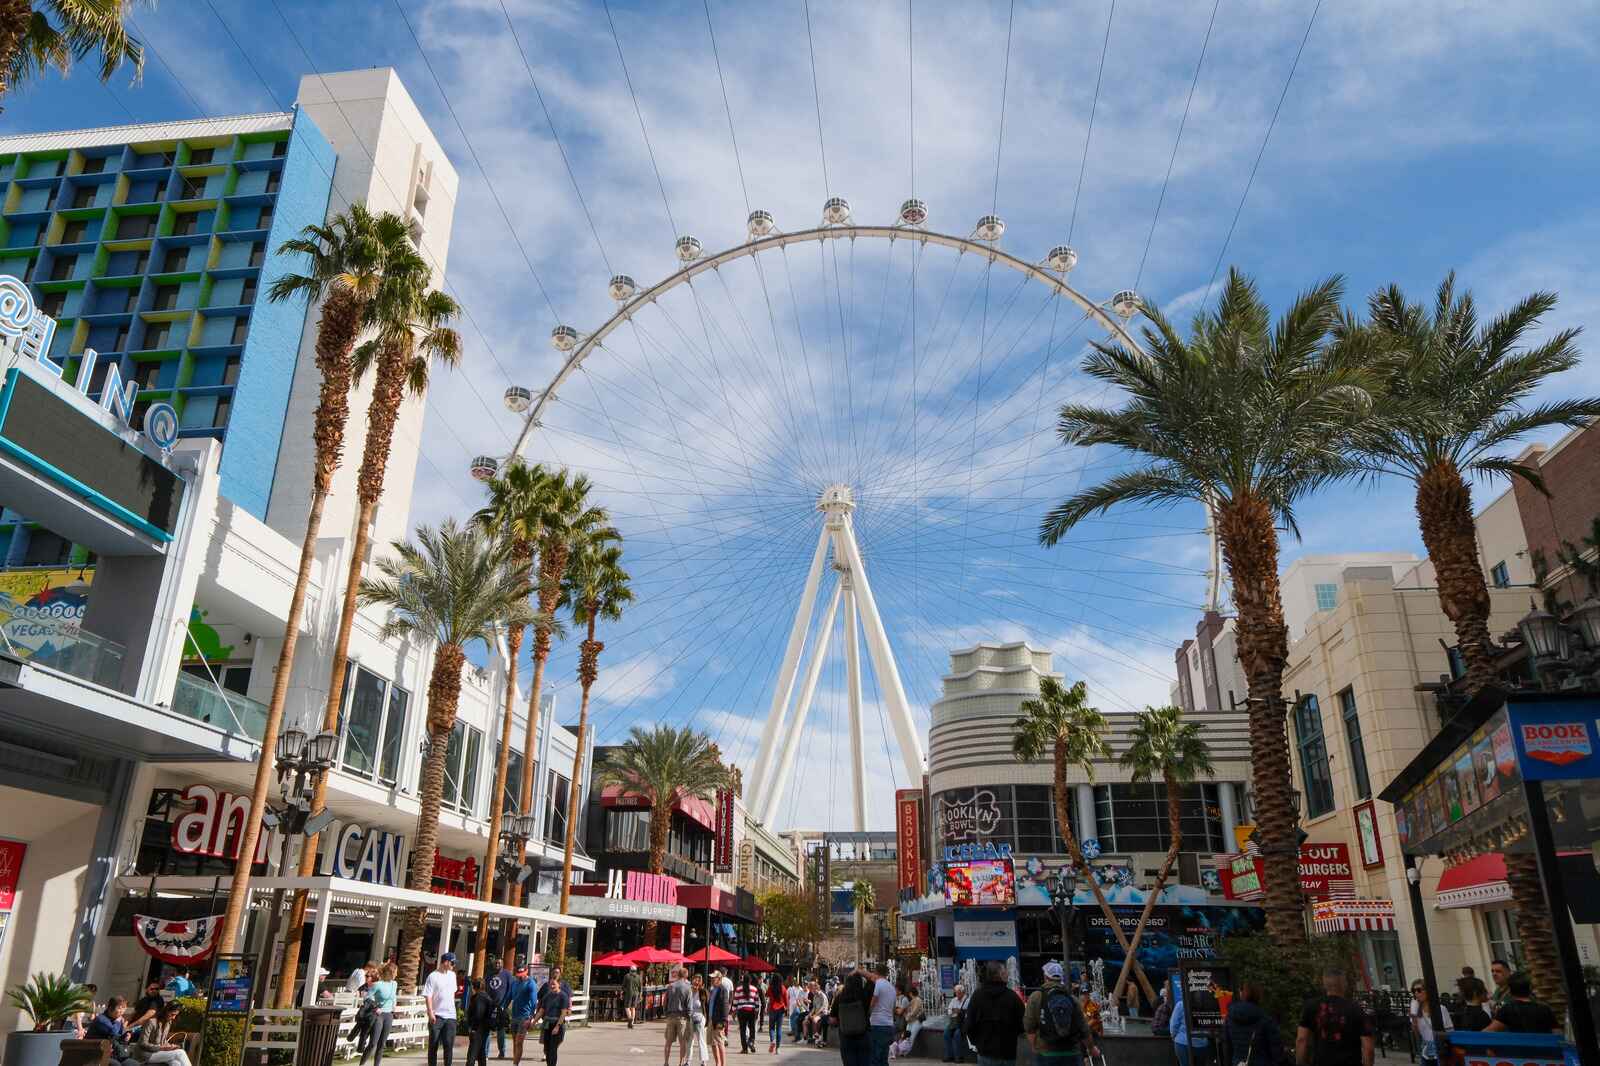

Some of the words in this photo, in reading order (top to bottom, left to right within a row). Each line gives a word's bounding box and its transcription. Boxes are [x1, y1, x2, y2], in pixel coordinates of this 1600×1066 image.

[37, 316, 178, 450] LINQ
[1524, 725, 1585, 739] BOOK
[942, 806, 993, 824] OOKLYN
[949, 819, 974, 831] BOWL
[1299, 847, 1339, 860] -OUT
[818, 847, 826, 883] YARD
[605, 869, 623, 899] JA
[1300, 880, 1322, 889] ELAY
[1091, 917, 1144, 926] DREMBOX
